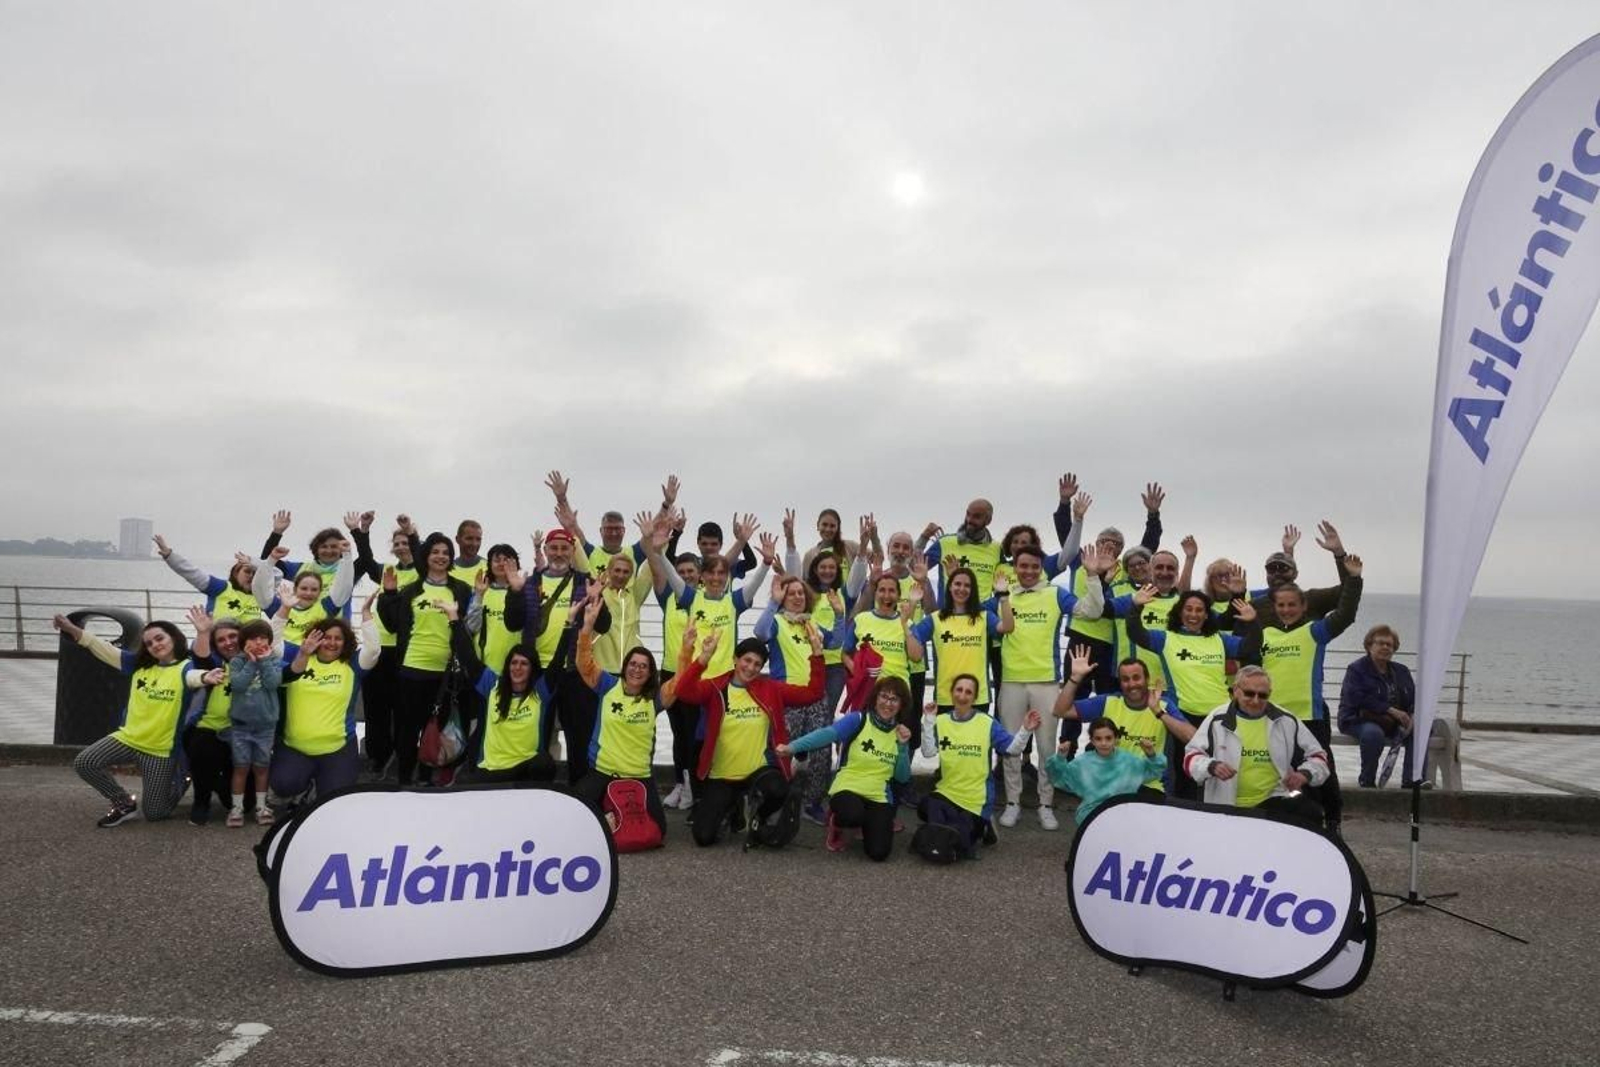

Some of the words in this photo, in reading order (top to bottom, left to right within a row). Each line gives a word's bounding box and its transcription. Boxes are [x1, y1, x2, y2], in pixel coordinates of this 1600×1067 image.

[1447, 97, 1600, 466] Atlántic
[872, 640, 904, 649] DEPORTE
[296, 840, 602, 912] Atlántico
[1083, 851, 1337, 936] Atlántico
